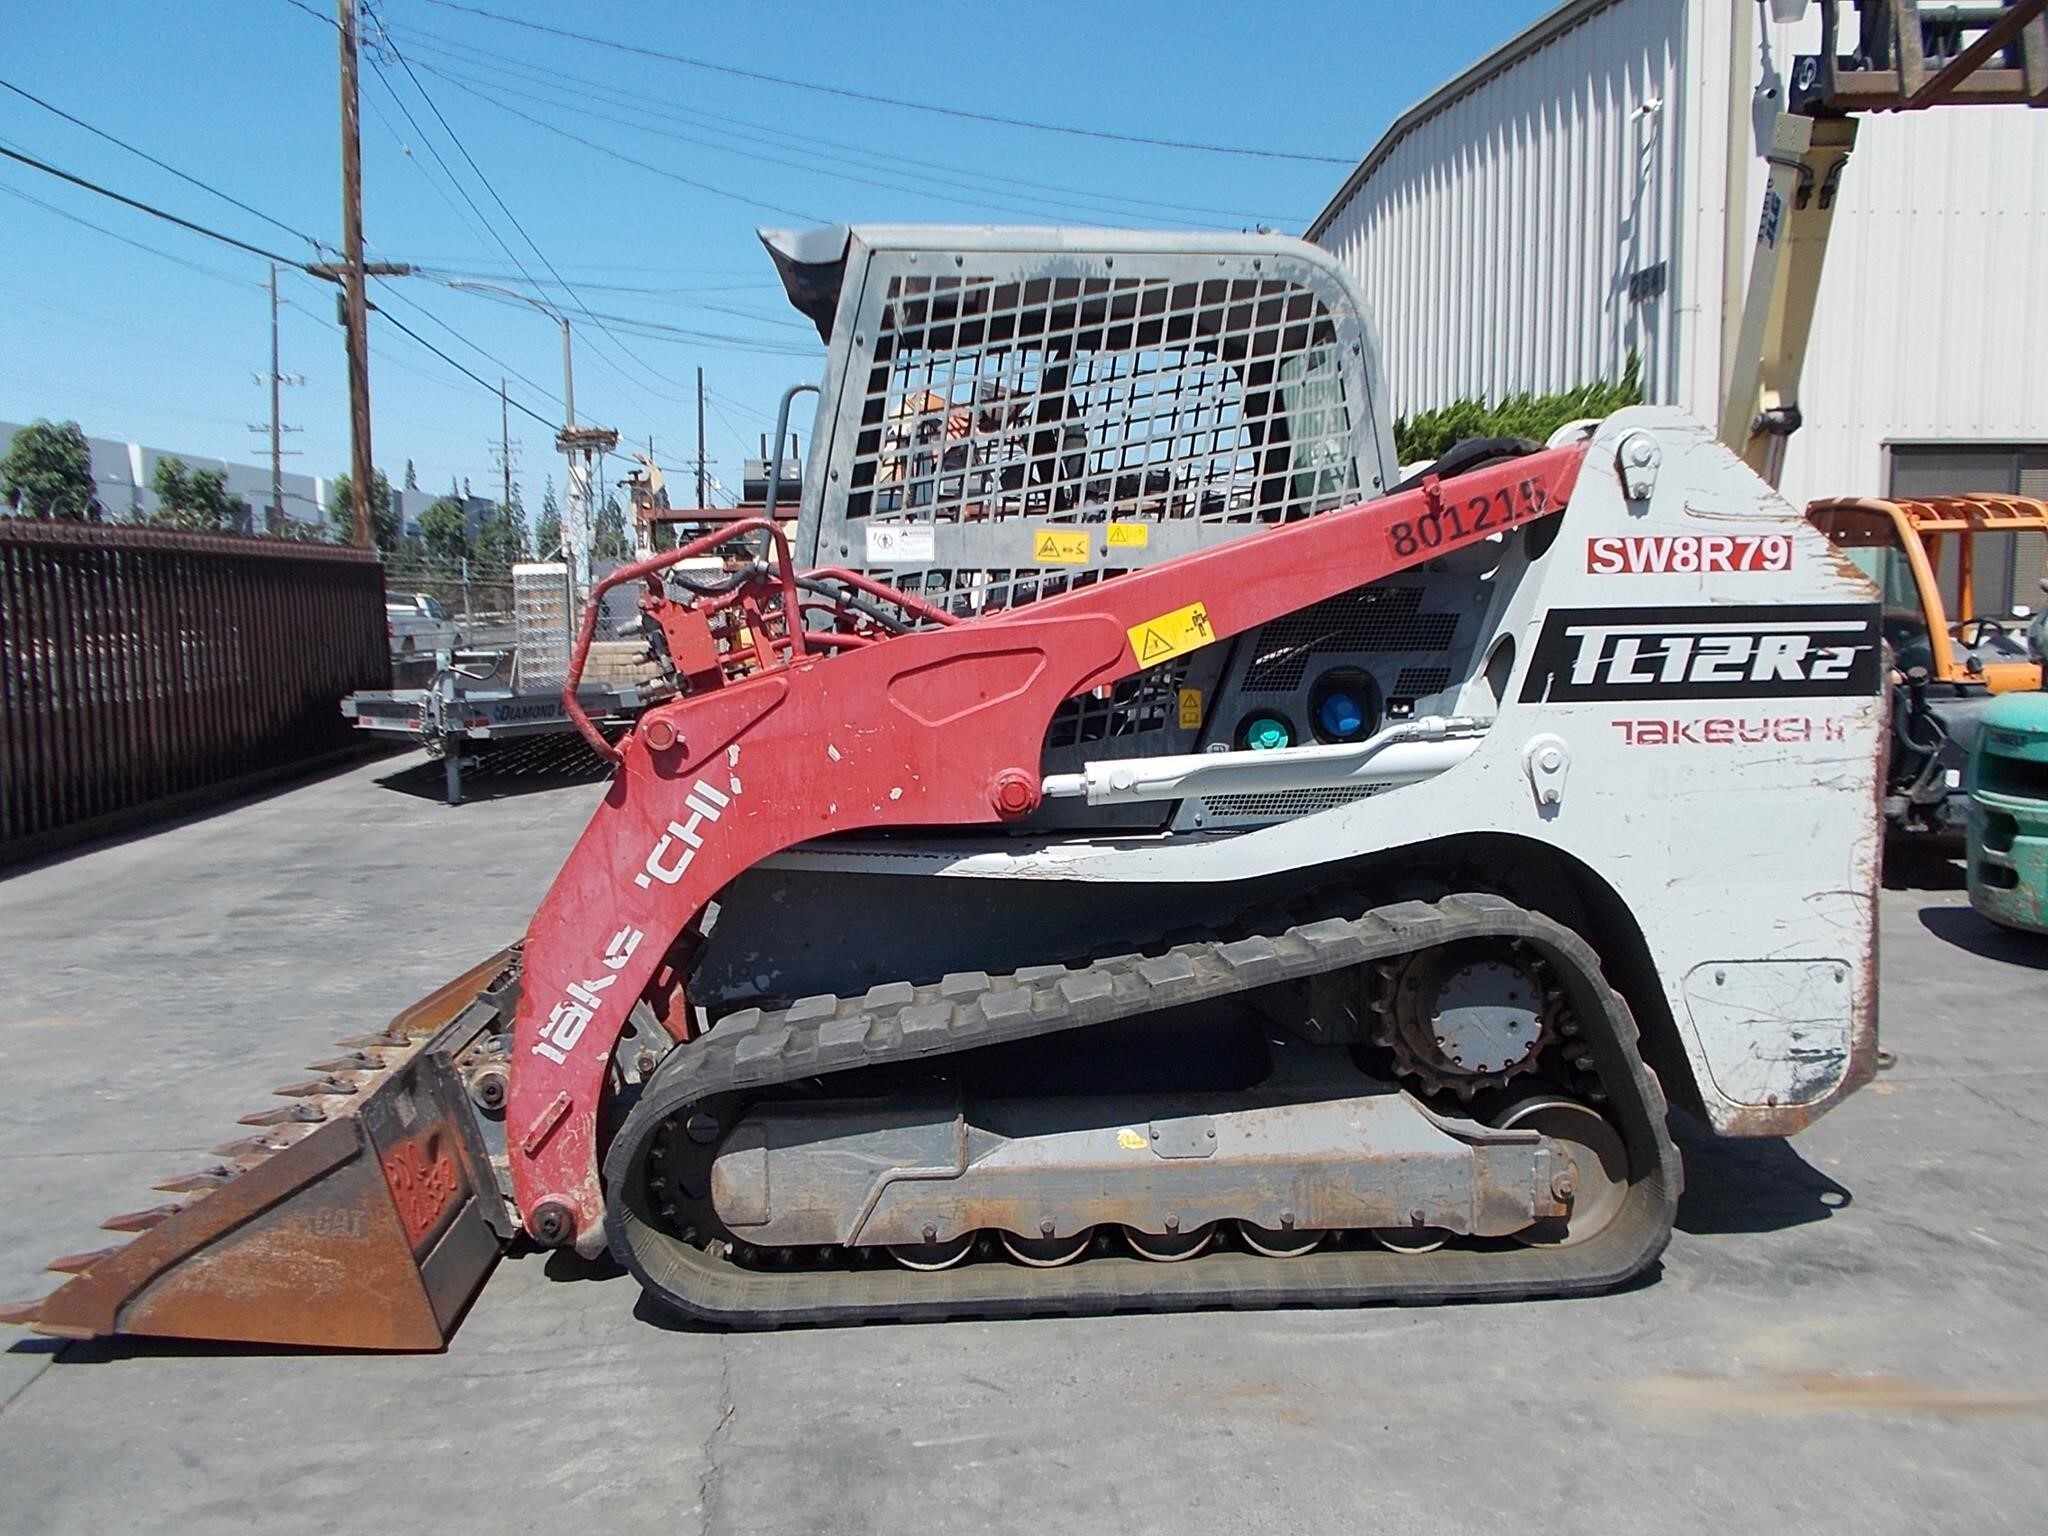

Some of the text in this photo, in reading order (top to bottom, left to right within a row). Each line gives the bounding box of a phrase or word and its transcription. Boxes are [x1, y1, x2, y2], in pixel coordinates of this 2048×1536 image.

[1391, 475, 1547, 557] 801215
[1592, 536, 1789, 573] SW8R79
[501, 704, 556, 721] DIAMOND
